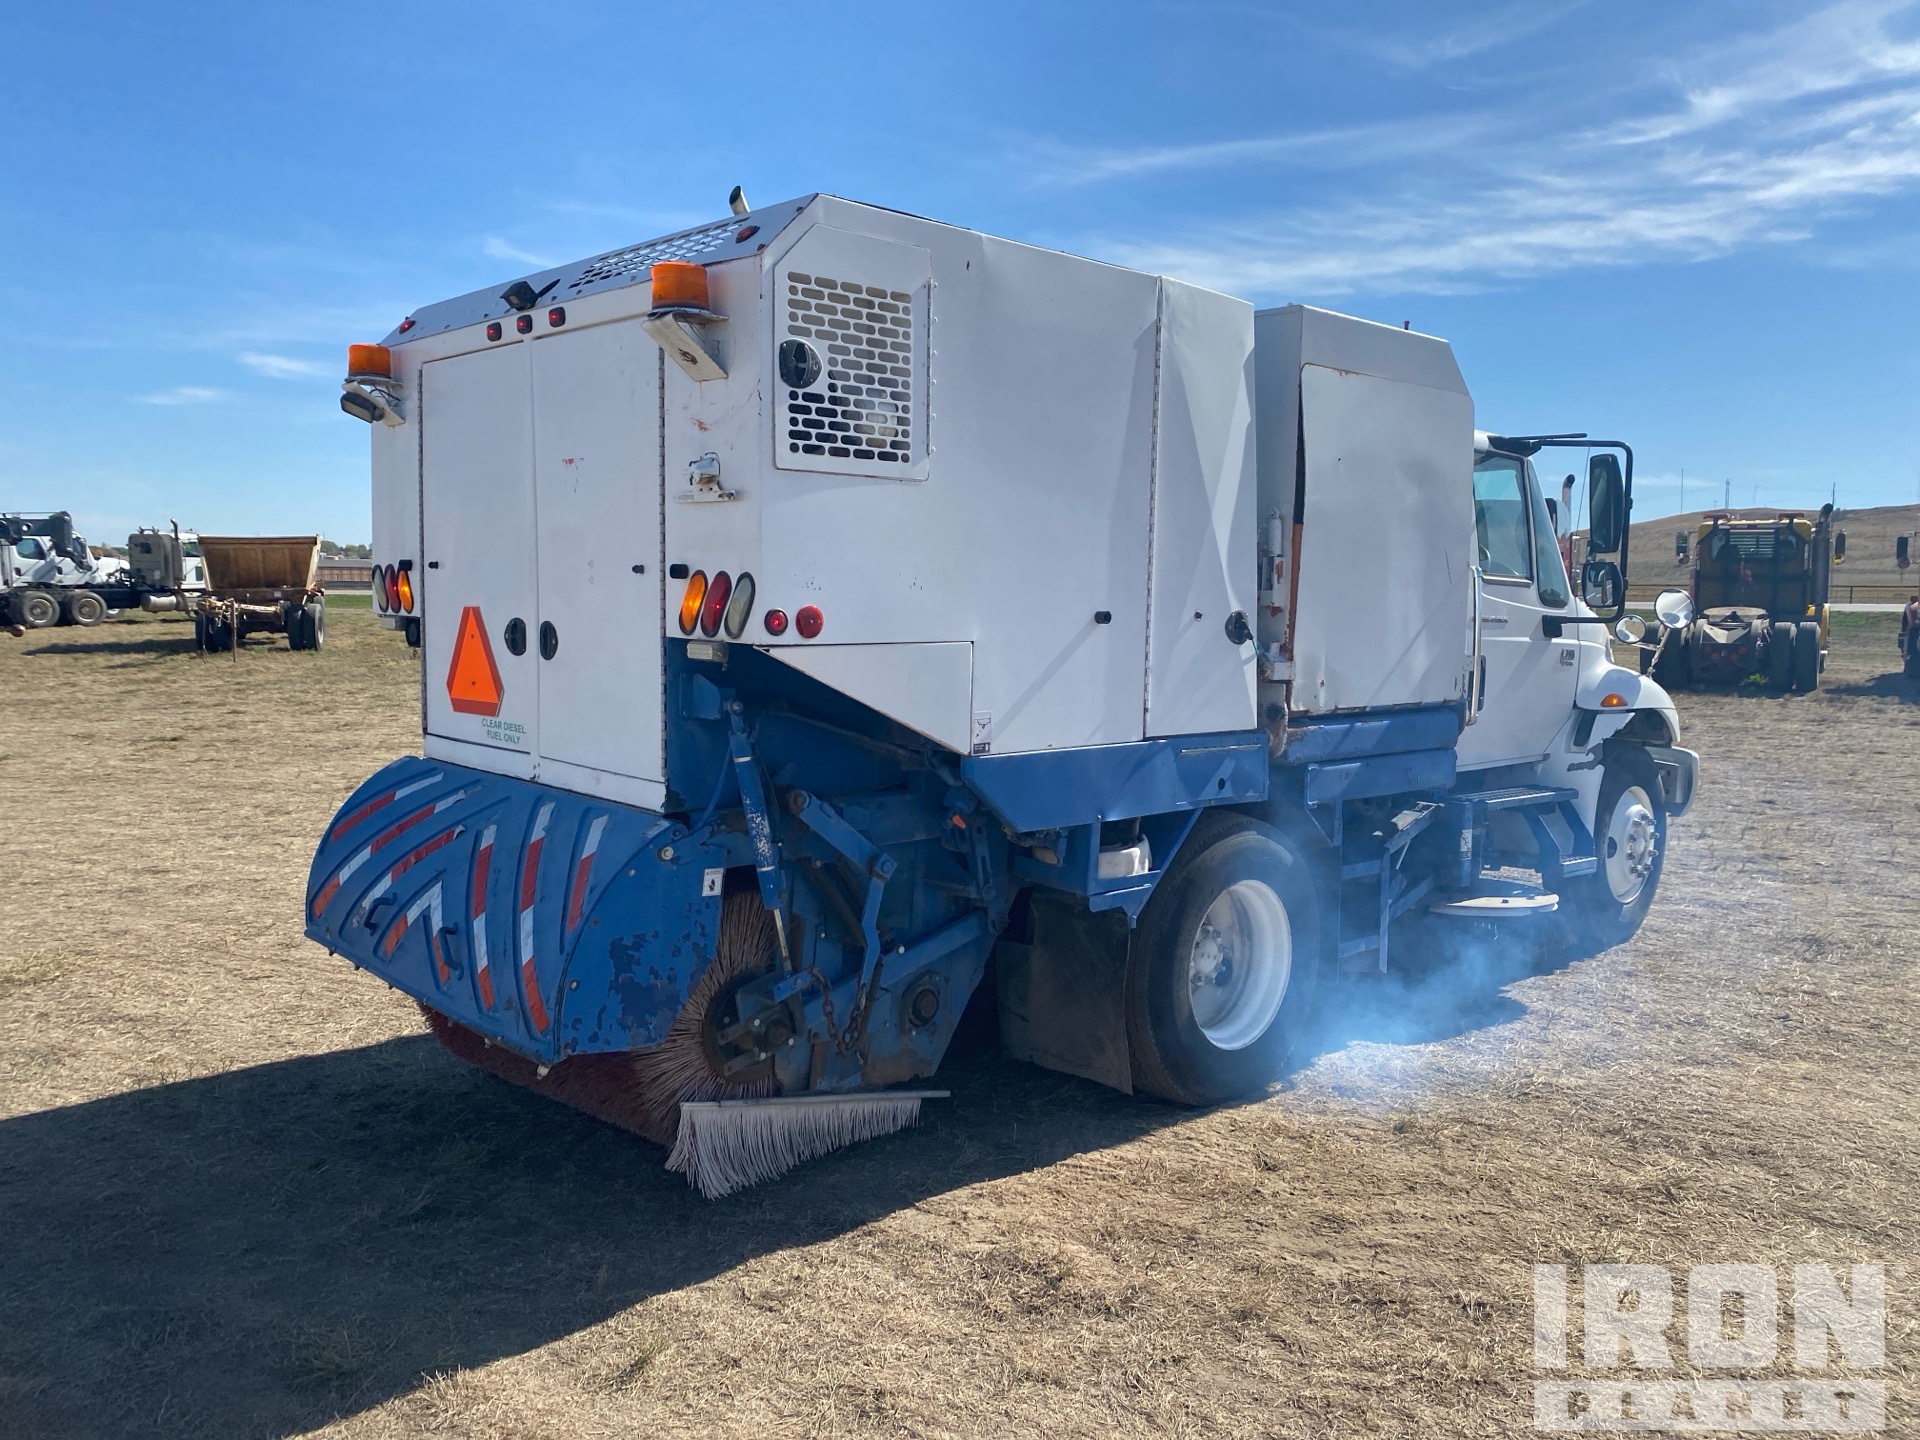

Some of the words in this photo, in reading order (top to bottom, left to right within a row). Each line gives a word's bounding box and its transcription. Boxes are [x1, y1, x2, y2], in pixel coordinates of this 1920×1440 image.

[482, 718, 502, 729] CLEAR
[503, 722, 526, 734] DIESEL
[487, 730, 503, 741] FUEL
[504, 733, 520, 744] ONLY
